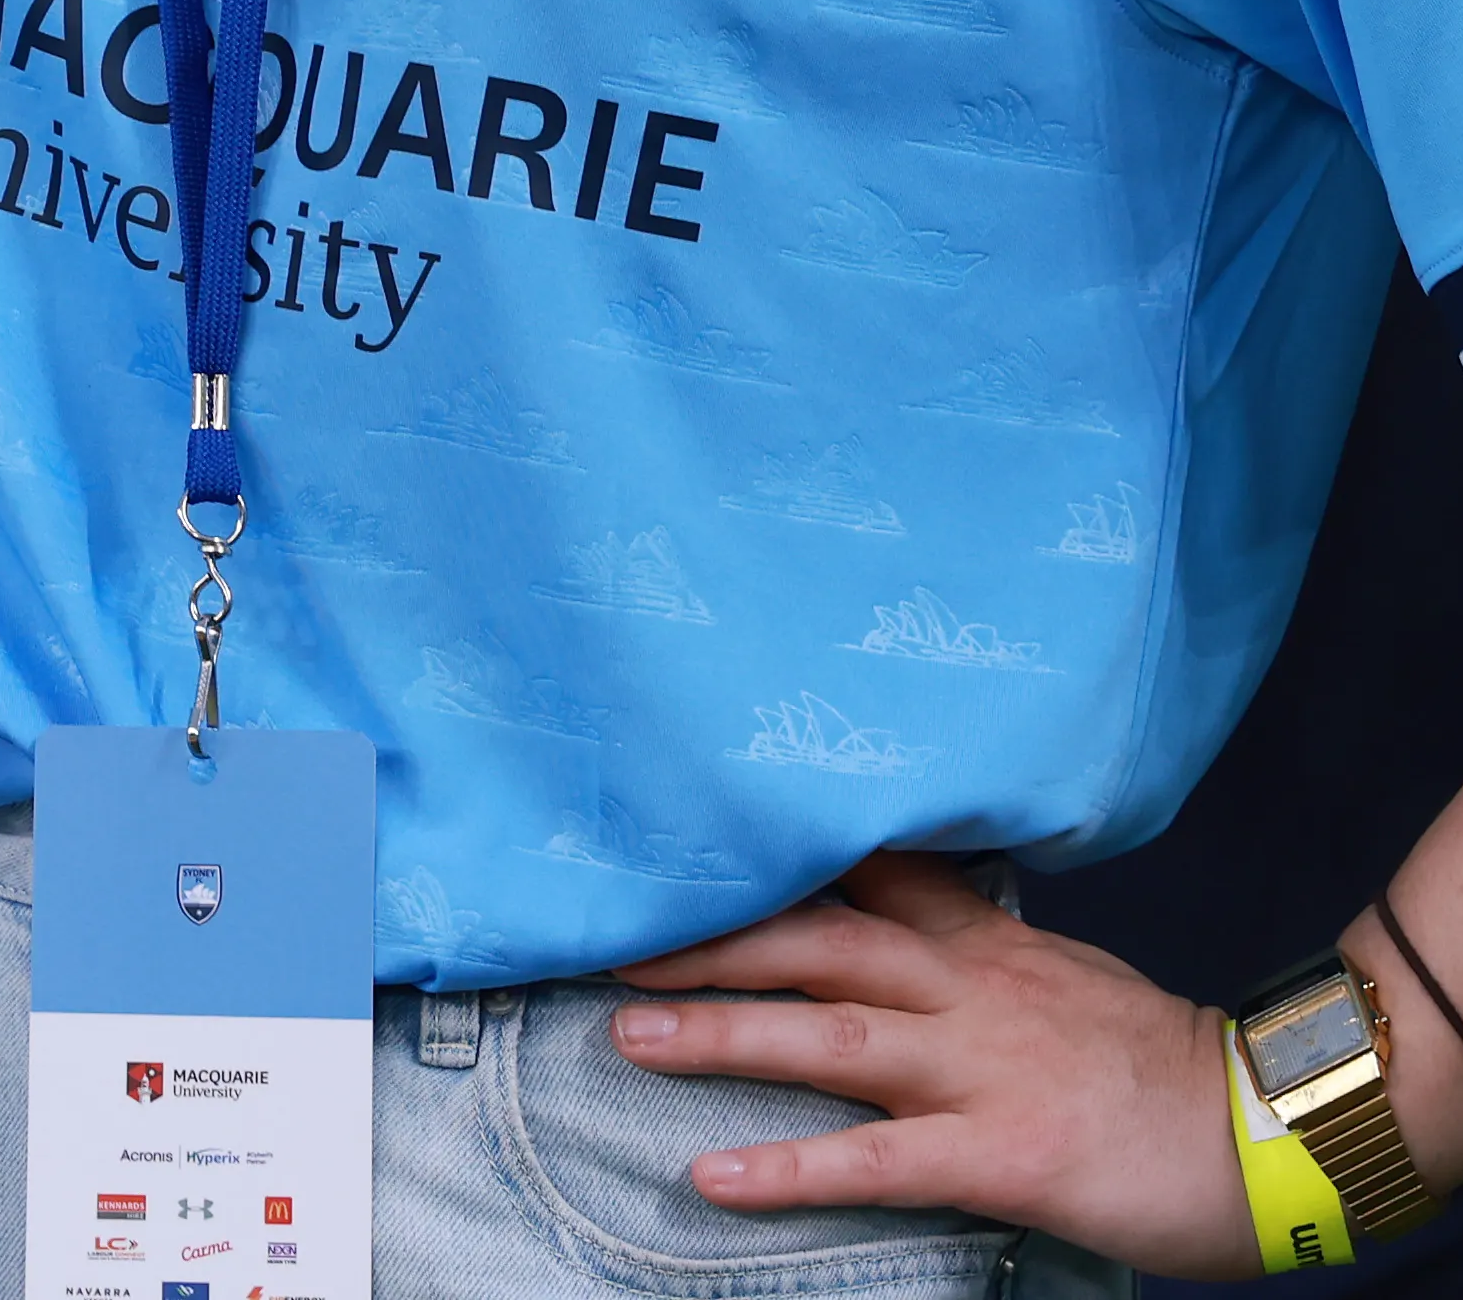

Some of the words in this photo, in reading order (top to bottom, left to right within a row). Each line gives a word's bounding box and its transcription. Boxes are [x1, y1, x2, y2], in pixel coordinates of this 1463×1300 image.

[183, 868, 216, 877] SYDNEY
[173, 1069, 269, 1086] MACQUARIE
[172, 1084, 242, 1102] University
[120, 1148, 174, 1162] Acronis
[186, 1149, 241, 1166] Hyperix
[98, 1200, 145, 1211] KENNARDS
[181, 1240, 234, 1262] Carma
[66, 1287, 131, 1297] NAVARRA
